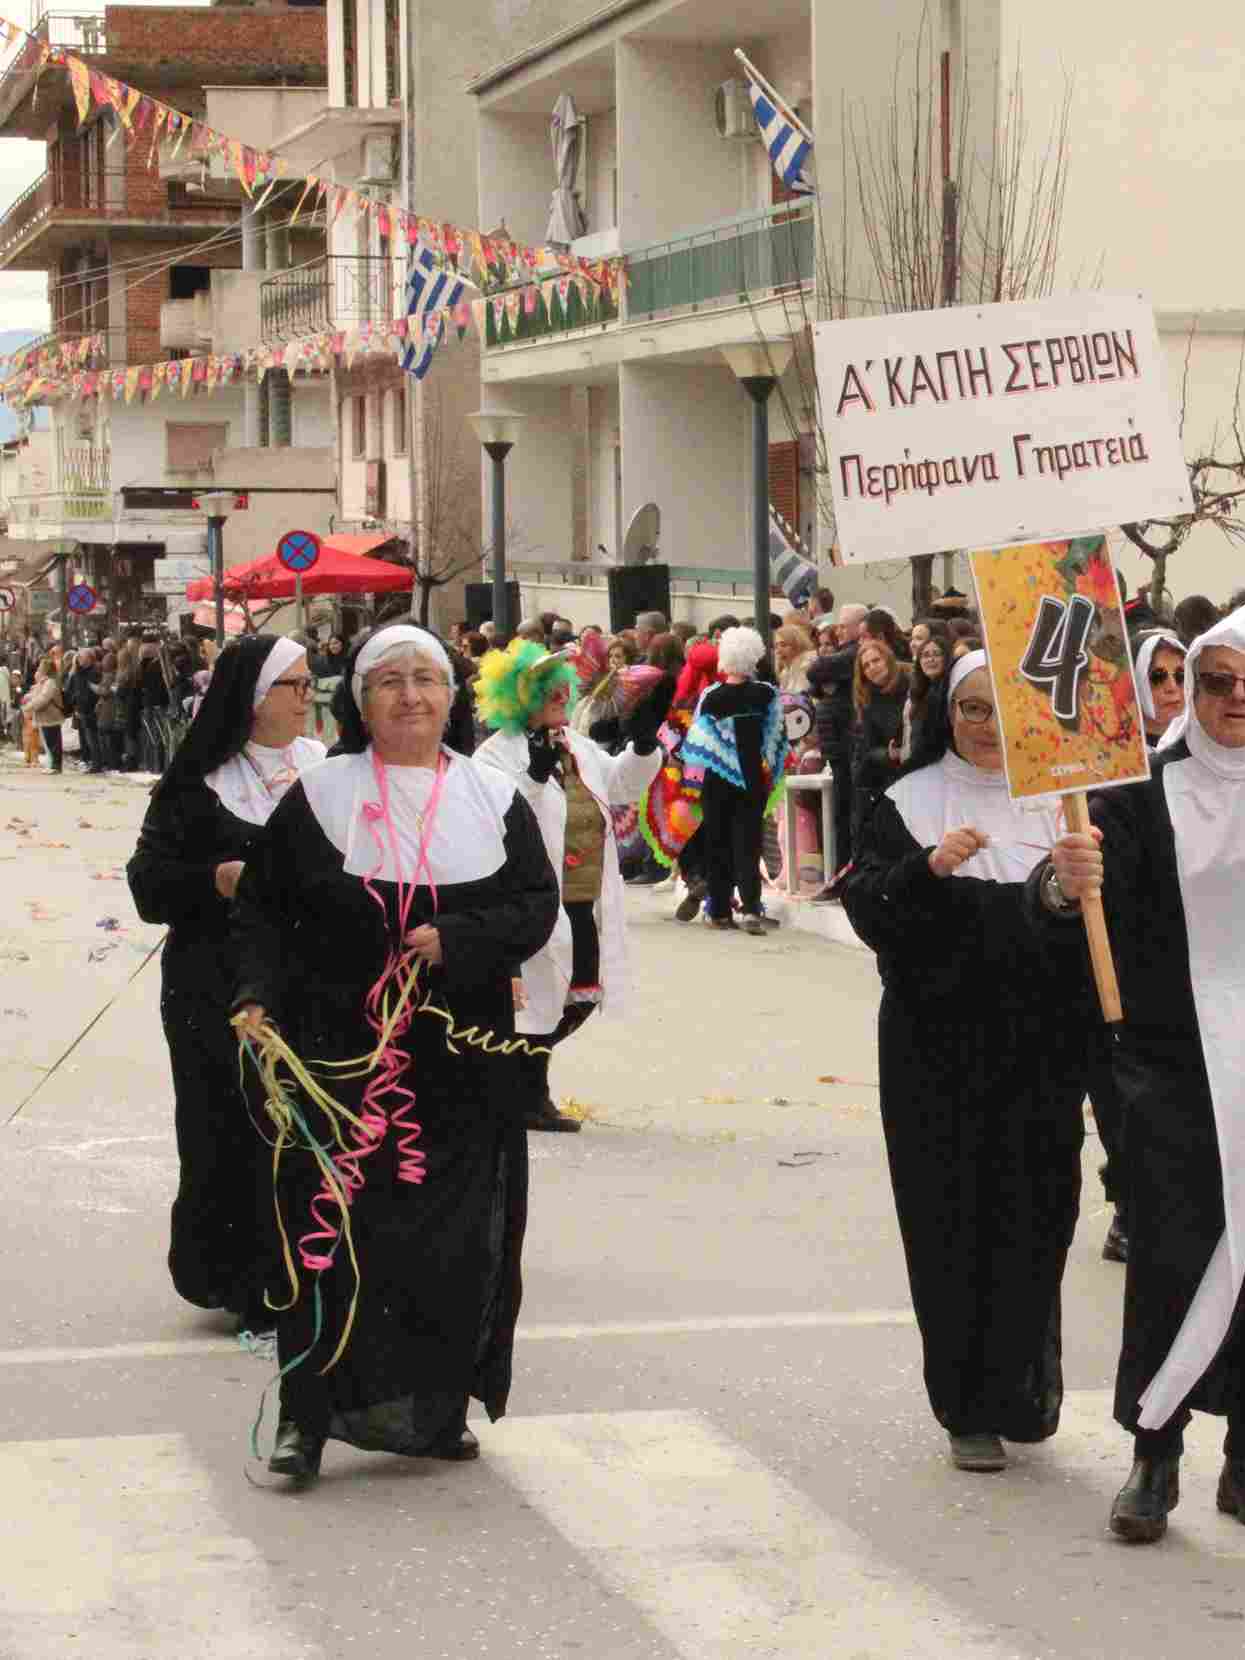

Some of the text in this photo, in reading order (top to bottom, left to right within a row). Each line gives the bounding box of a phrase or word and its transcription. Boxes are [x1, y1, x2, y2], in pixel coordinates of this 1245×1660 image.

[884, 346, 994, 407] ΚΑΠΗ
[1000, 328, 1140, 394] ΣΕΡΒΙΩΝ
[838, 416, 1149, 505] Περήφανα Γηρατειά
[1019, 594, 1095, 719] 4
